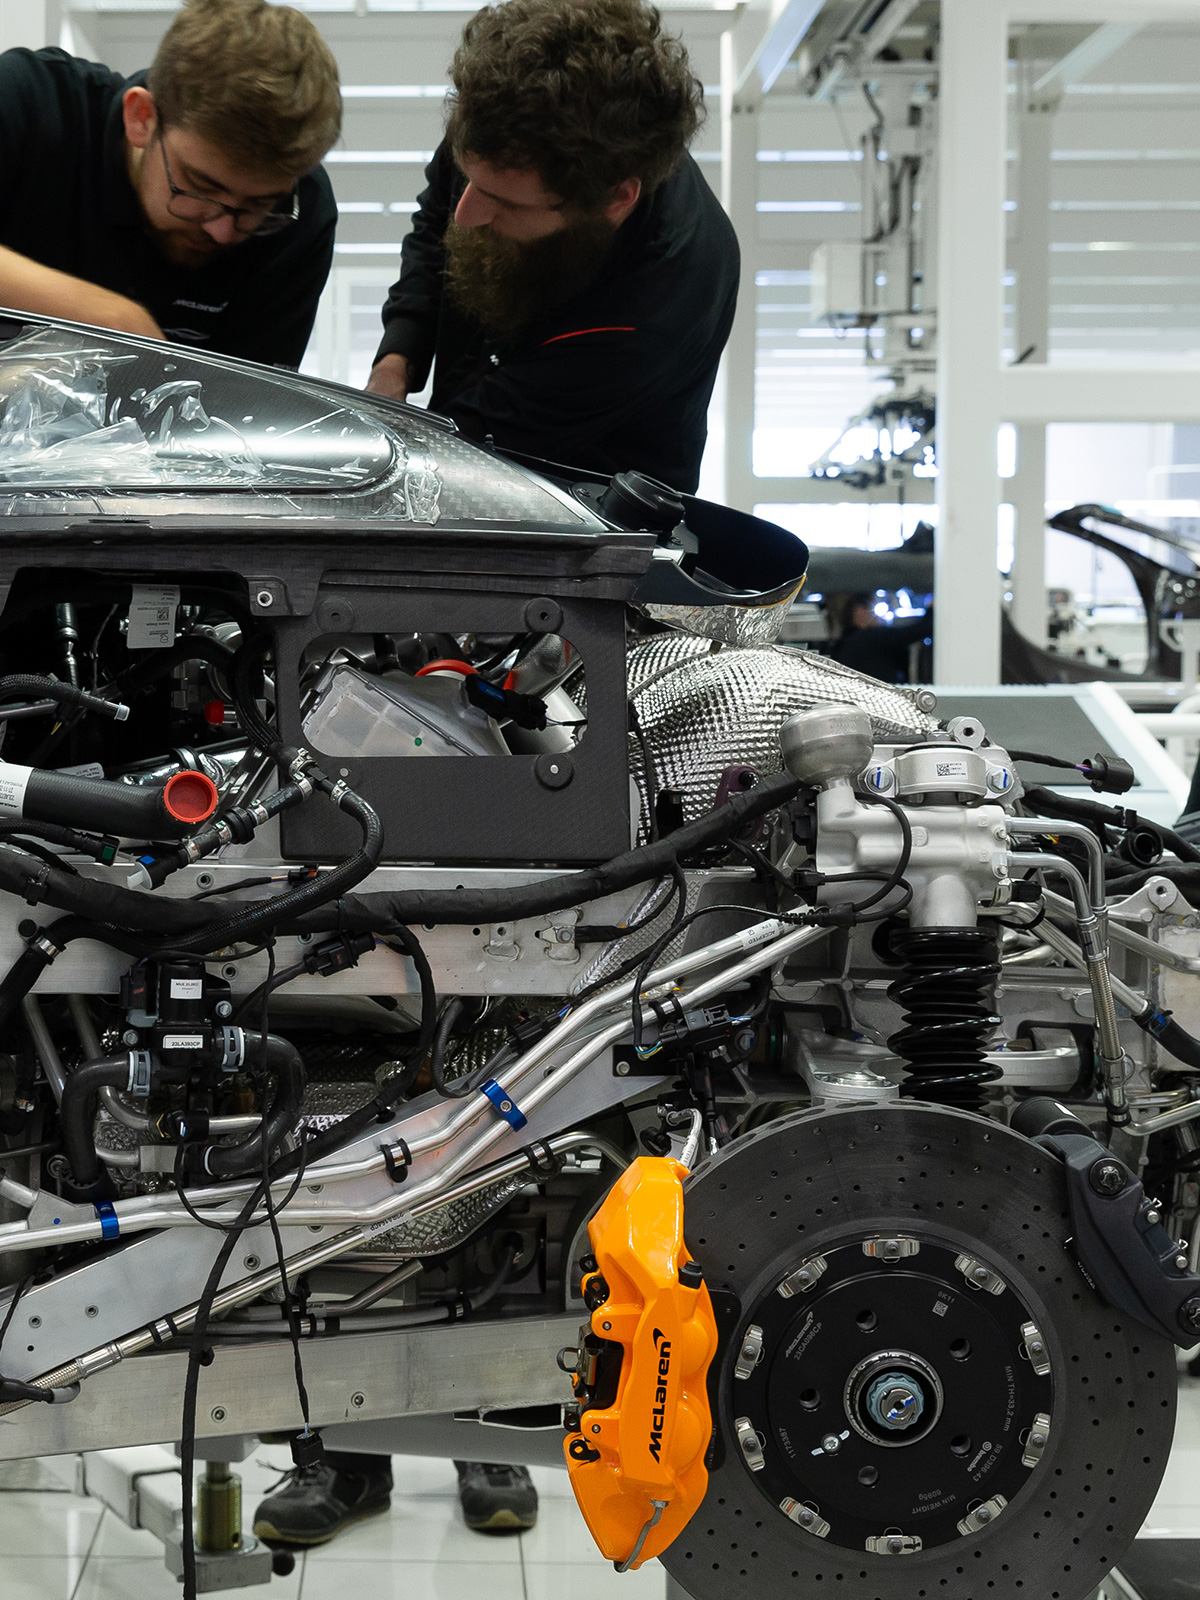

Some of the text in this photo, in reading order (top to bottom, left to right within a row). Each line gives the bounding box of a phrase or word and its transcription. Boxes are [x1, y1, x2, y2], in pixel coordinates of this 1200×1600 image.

[785, 1311, 814, 1359] McLaren
[1004, 1365, 1014, 1382] MIN
[649, 1328, 671, 1465] McLaren
[1003, 1417, 1012, 1432] mm
[967, 1448, 987, 1472] brembo
[911, 1494, 956, 1515] MIN WEIGHT
